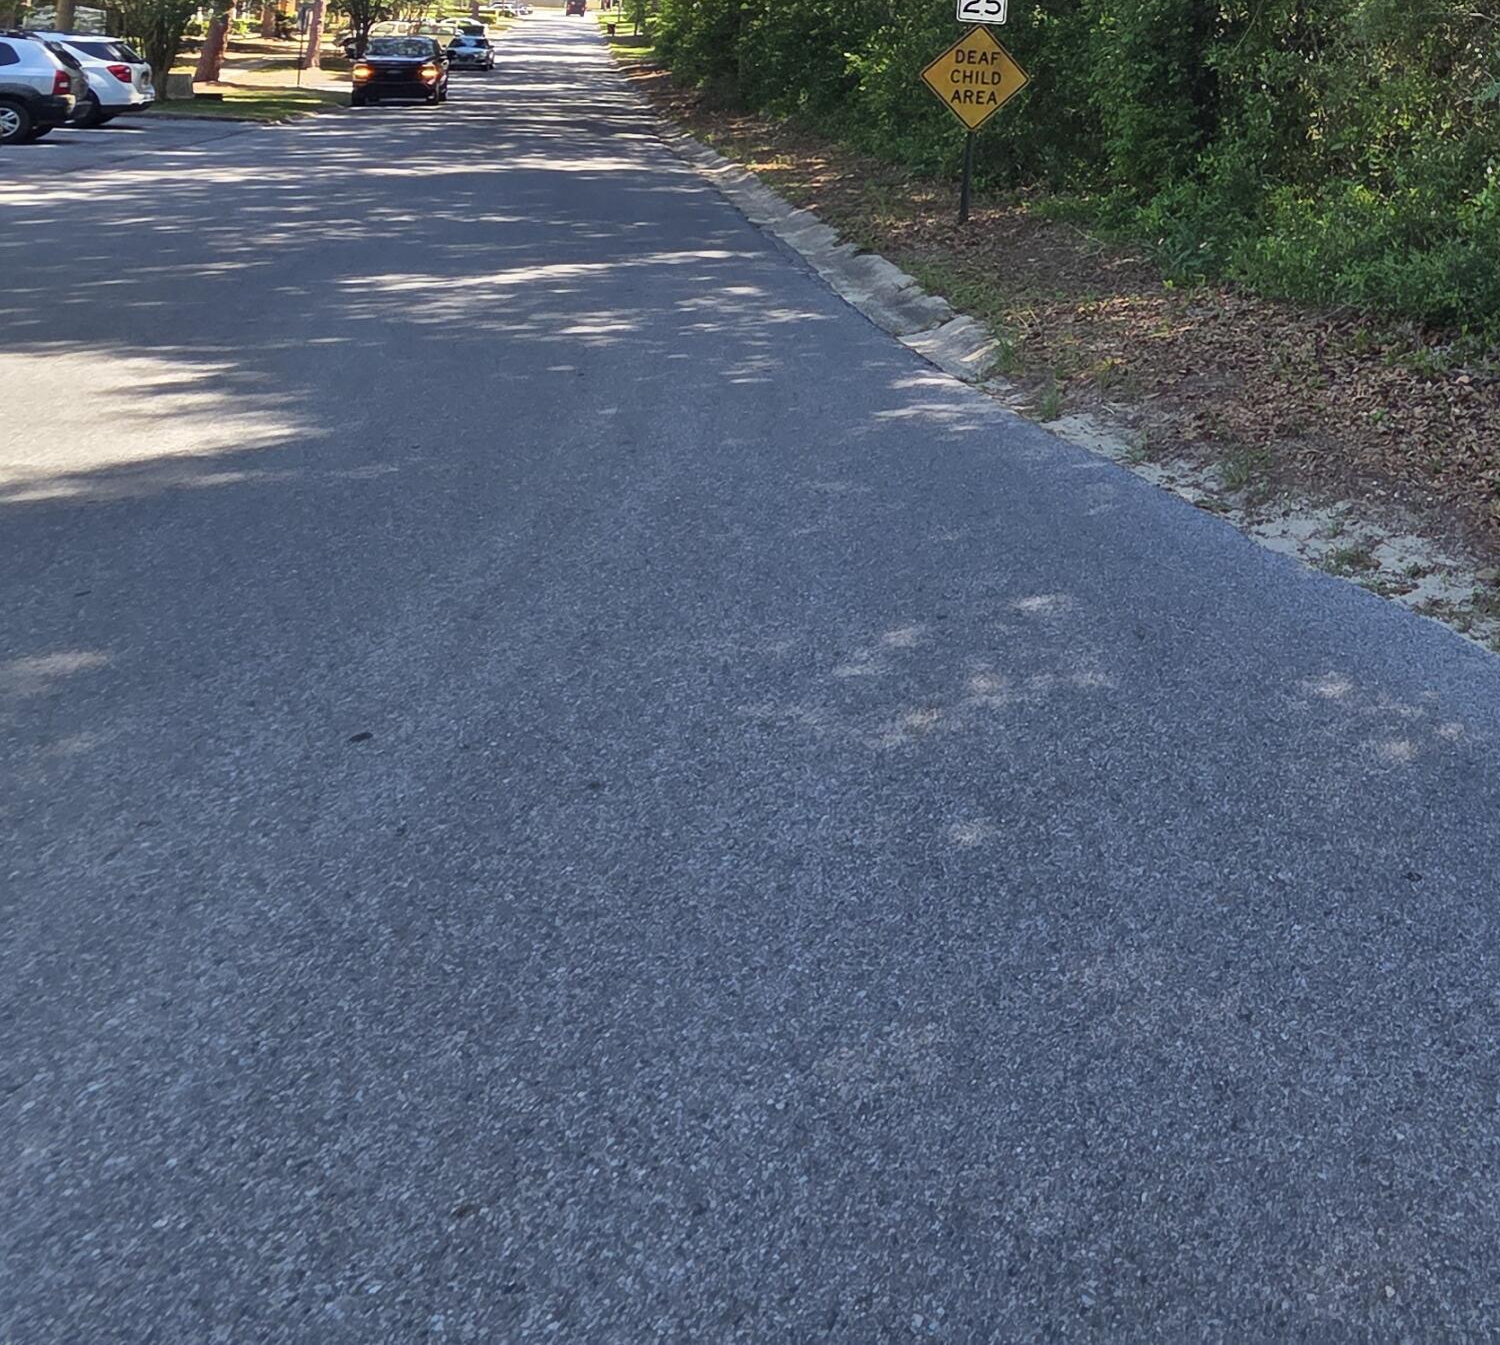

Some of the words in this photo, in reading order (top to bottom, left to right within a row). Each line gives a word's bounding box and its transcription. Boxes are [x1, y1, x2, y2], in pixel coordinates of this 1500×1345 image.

[955, 49, 1000, 66] DEAF
[950, 69, 1002, 85] CHILD
[950, 89, 998, 105] AREA
